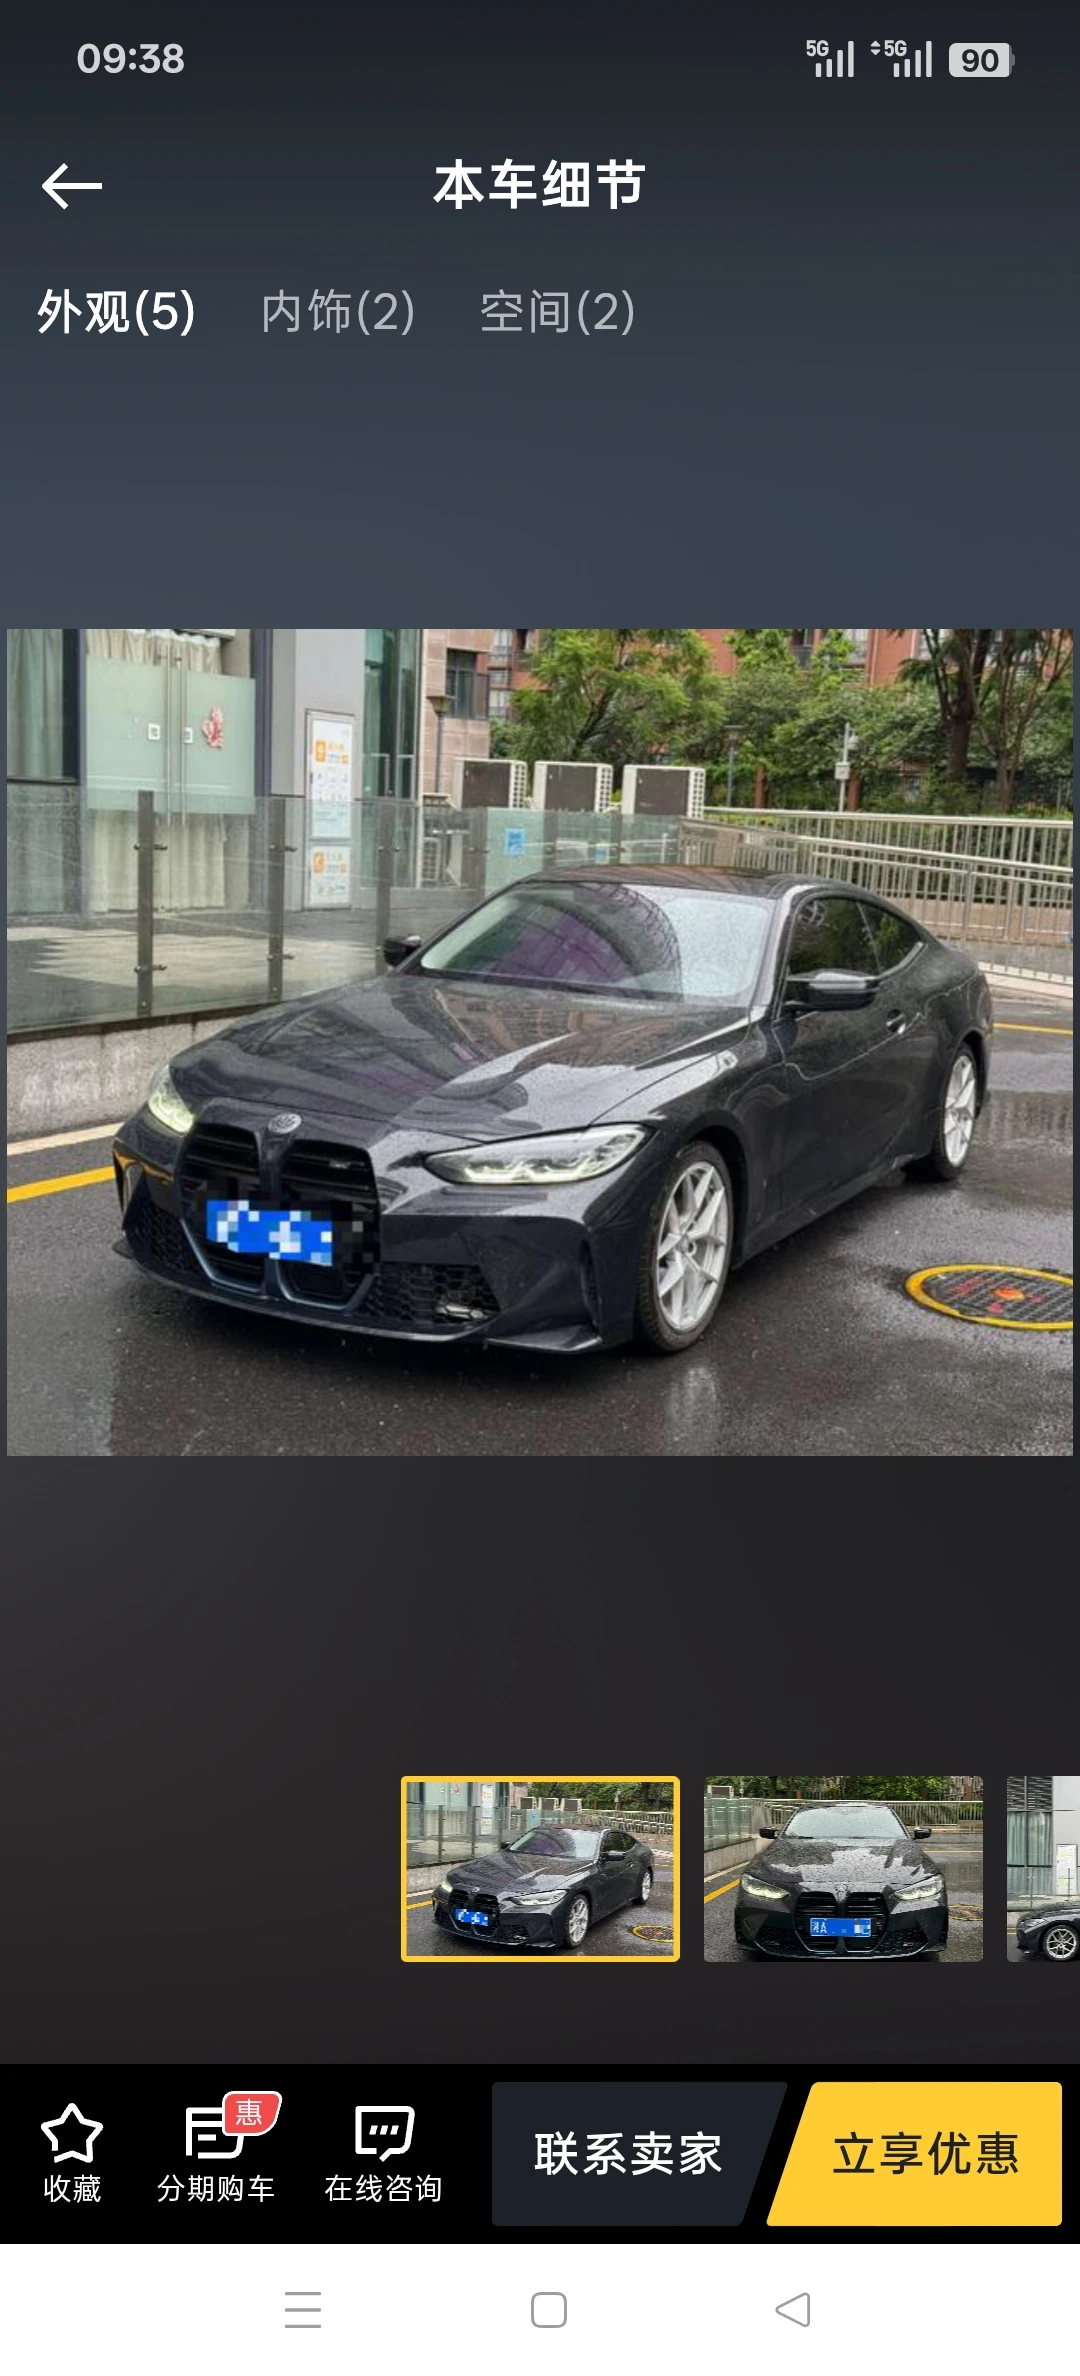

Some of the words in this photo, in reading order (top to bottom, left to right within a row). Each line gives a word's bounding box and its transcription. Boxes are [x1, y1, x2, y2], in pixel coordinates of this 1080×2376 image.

[77, 43, 185, 74] 09:38
[807, 40, 829, 57] 5G
[885, 40, 907, 57] 5G
[962, 49, 999, 72] 90
[433, 159, 646, 209] 本车细节
[37, 289, 195, 336] 外观(5)
[262, 289, 415, 335] 内饰(2)
[480, 289, 635, 335] 空间(2)
[236, 2099, 262, 2127] 惠
[534, 2131, 723, 2175] 联系卖家
[832, 2131, 1019, 2175] 立享优惠
[43, 2174, 101, 2203] 收藏
[157, 2174, 275, 2203] 分期购车
[325, 2174, 442, 2203] 在线咨询
